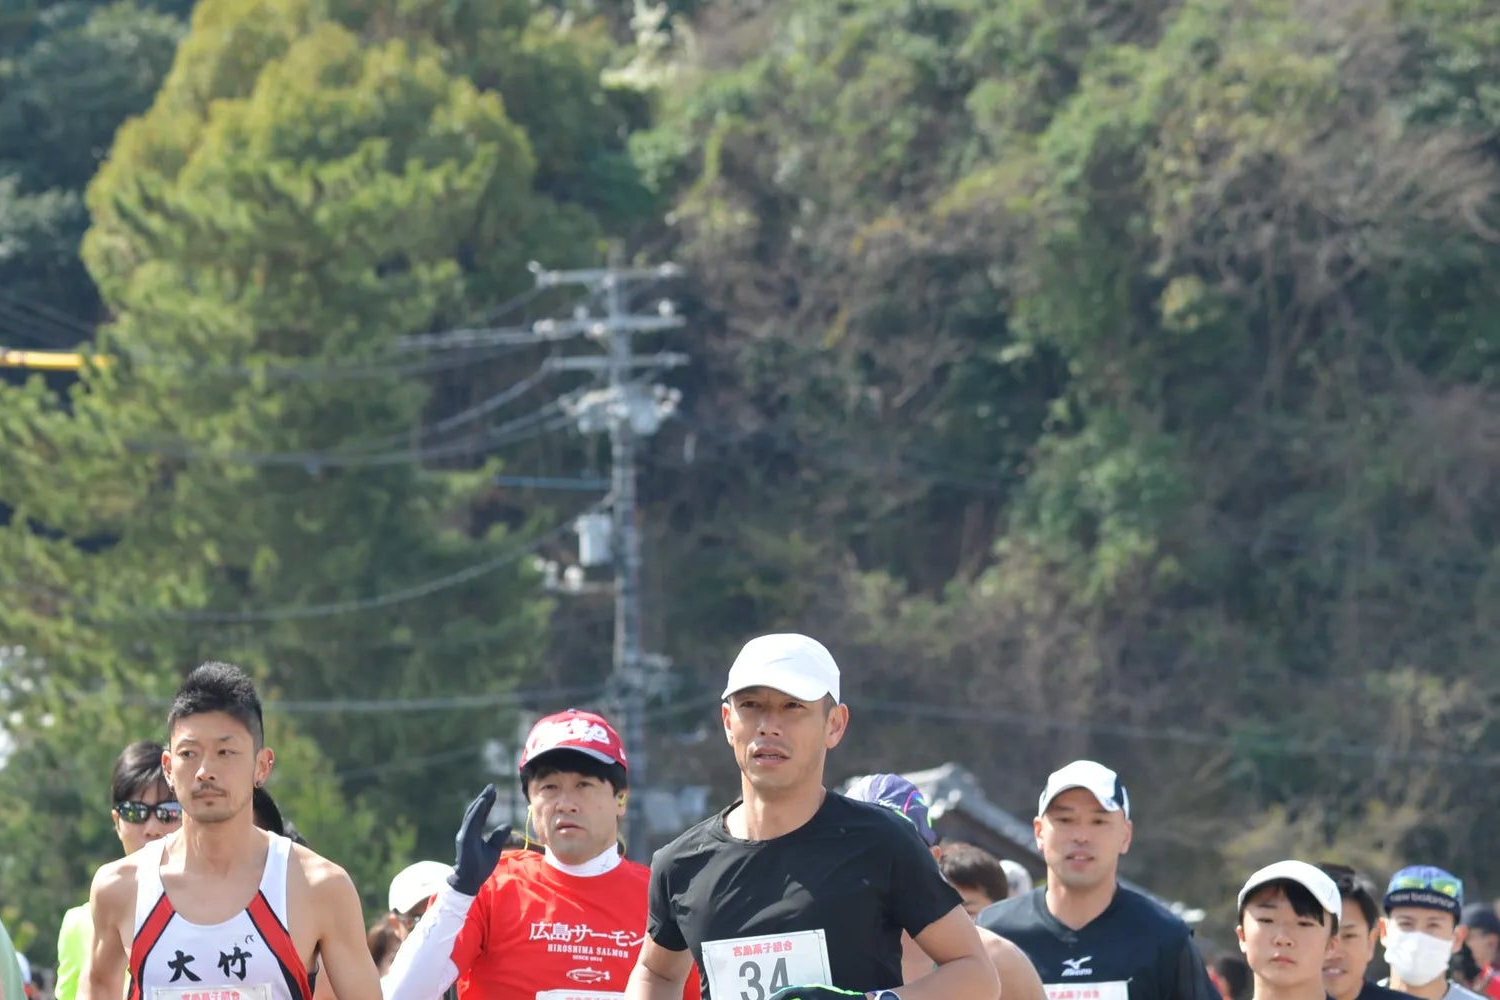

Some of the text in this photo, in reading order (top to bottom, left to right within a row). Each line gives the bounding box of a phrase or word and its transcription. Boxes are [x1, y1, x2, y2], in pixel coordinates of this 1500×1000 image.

[529, 921, 645, 947] 広島サーモン
[547, 943, 593, 955] HIROSHIMA
[596, 947, 628, 959] SALMON
[167, 947, 252, 982] 大竹
